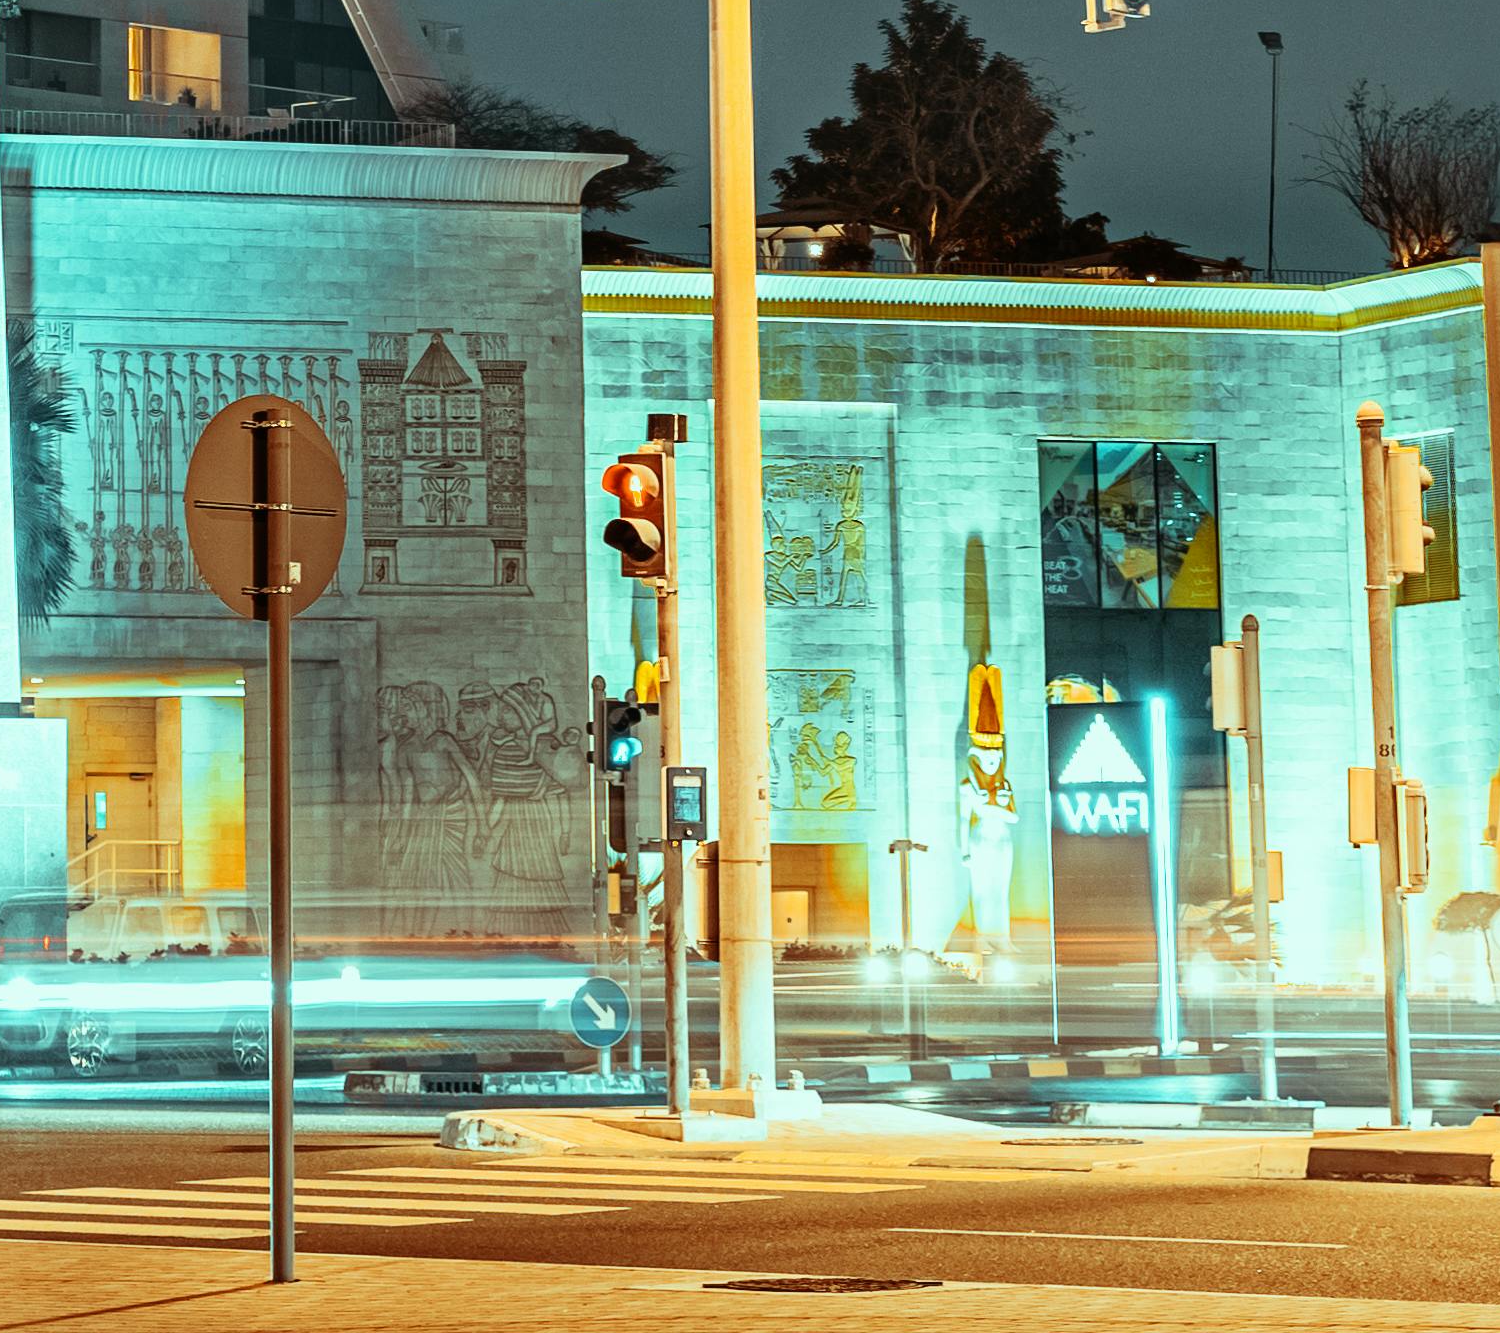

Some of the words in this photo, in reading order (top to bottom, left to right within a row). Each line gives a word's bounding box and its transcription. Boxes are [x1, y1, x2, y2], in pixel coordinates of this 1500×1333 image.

[1043, 560, 1067, 571] BEAT
[1044, 572, 1063, 582] THE
[1044, 584, 1069, 594] HEAT
[1057, 792, 1150, 834] WAFI
